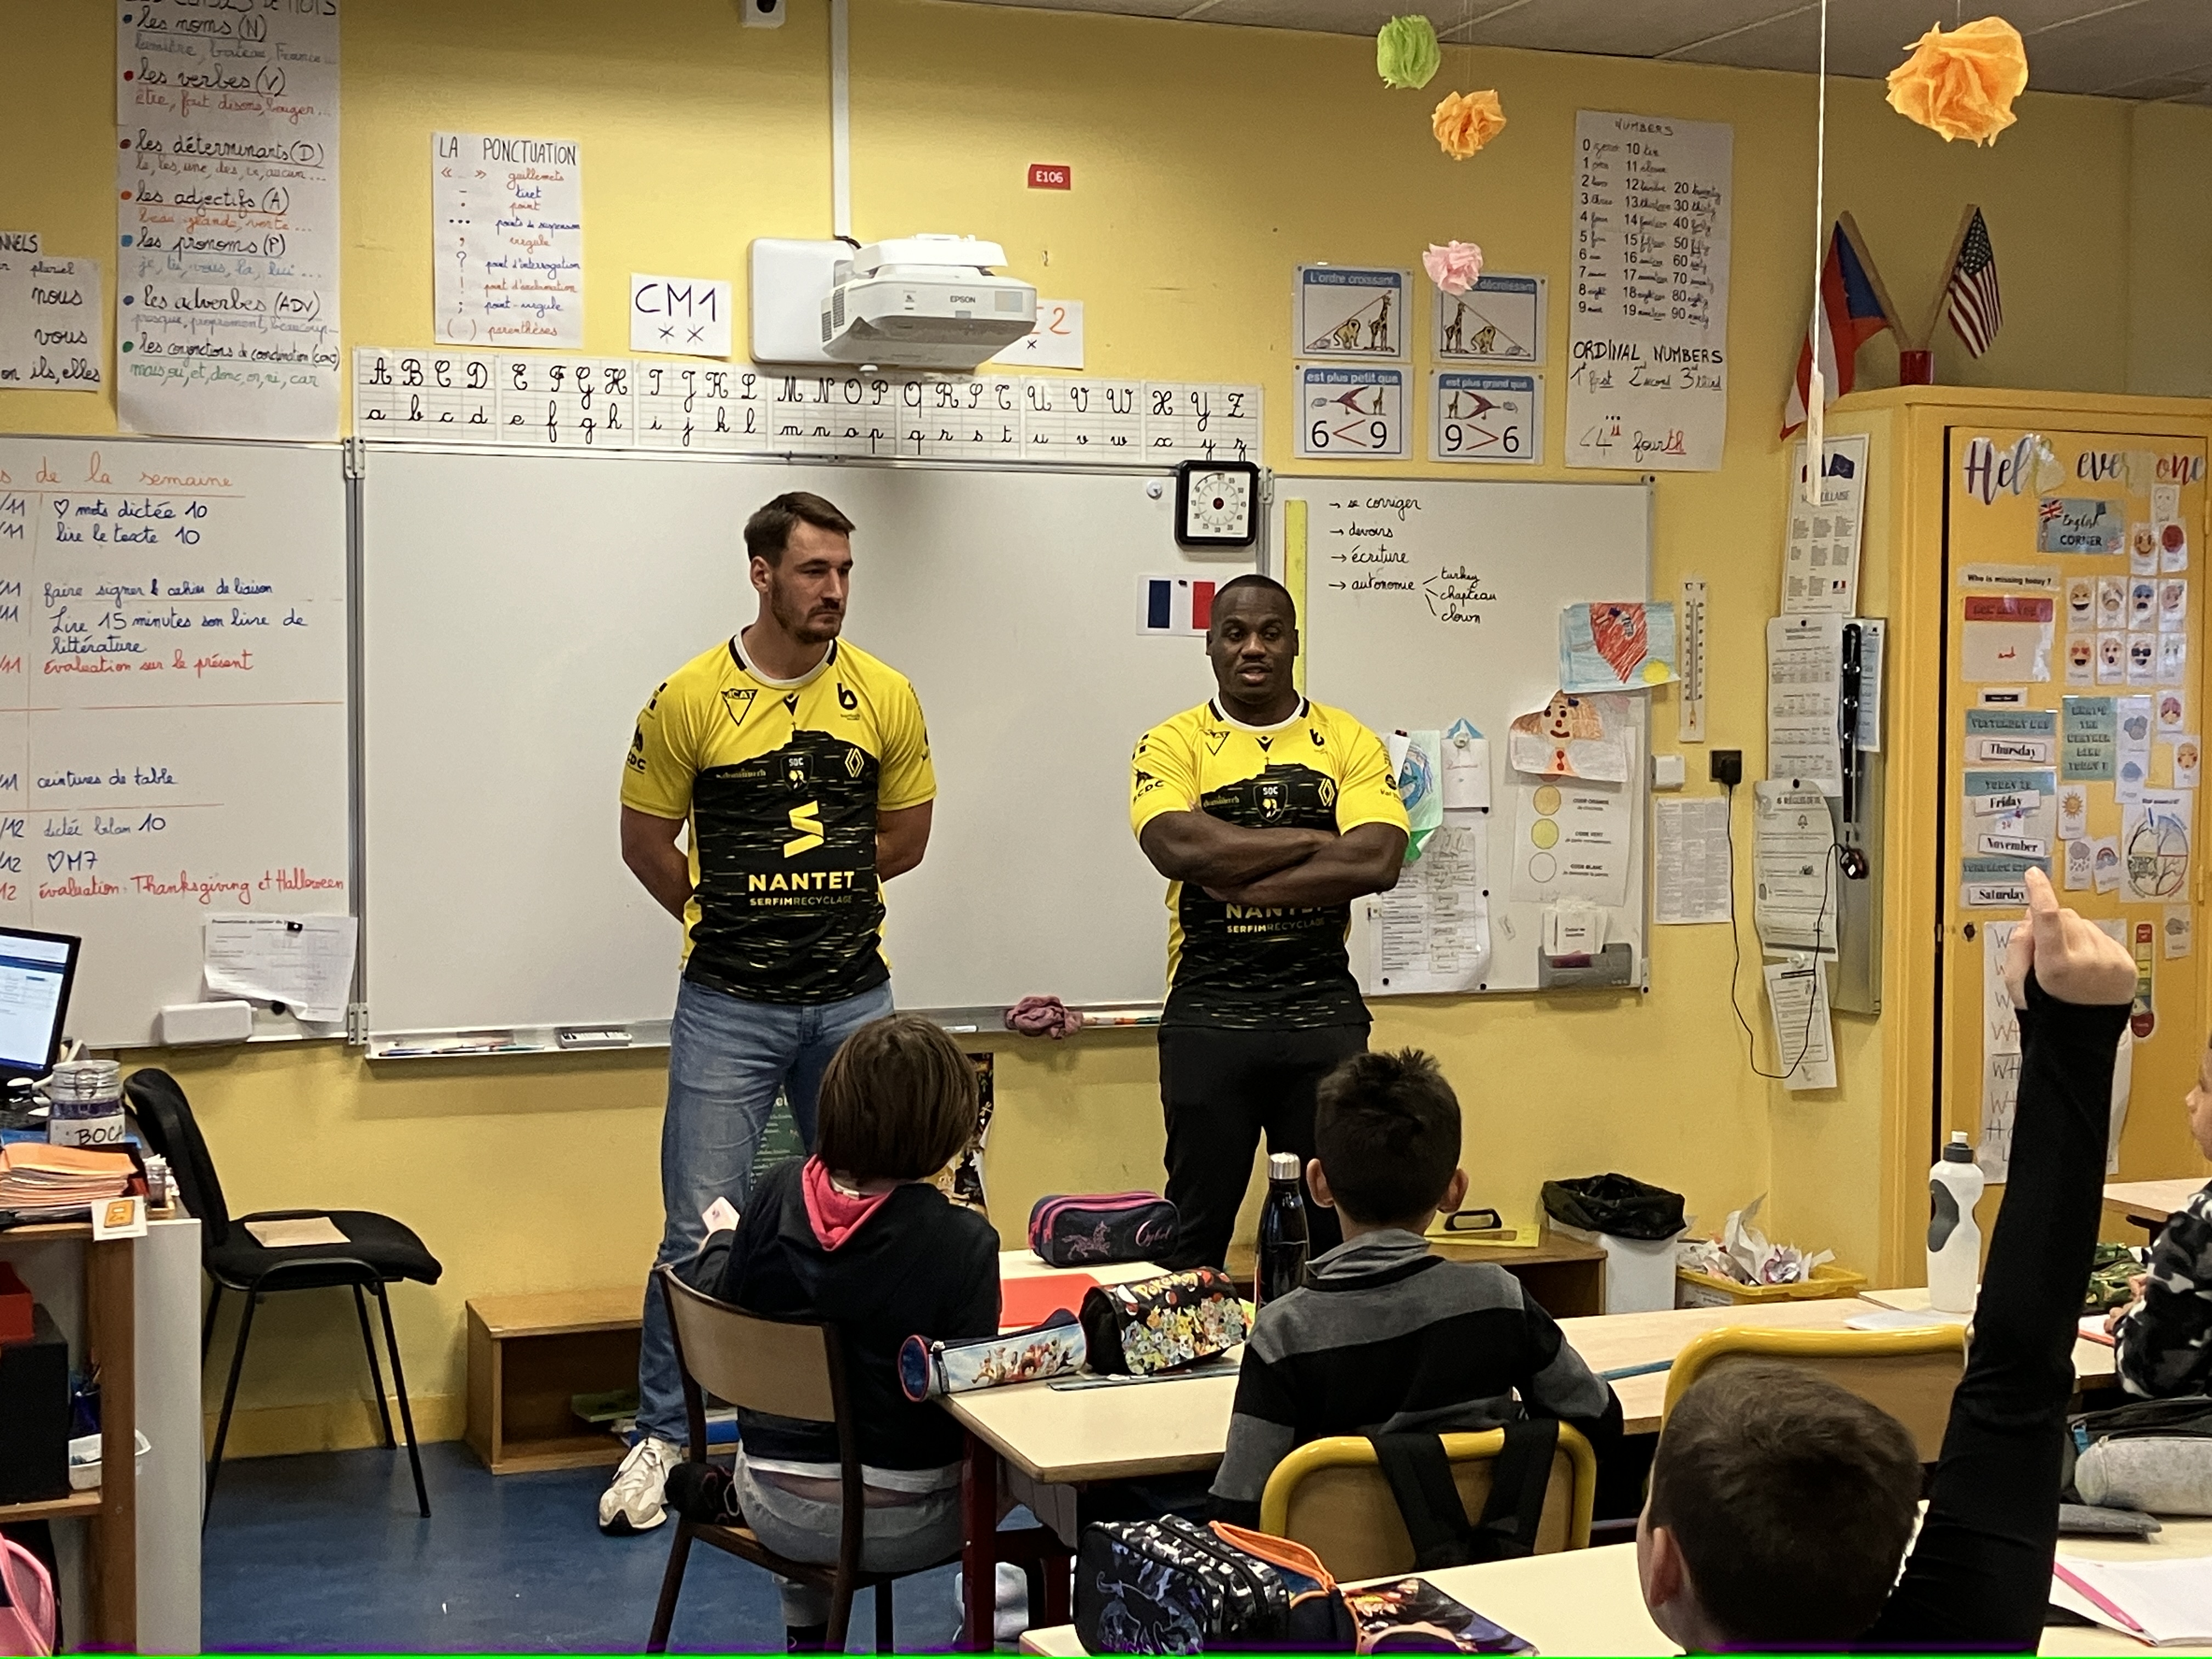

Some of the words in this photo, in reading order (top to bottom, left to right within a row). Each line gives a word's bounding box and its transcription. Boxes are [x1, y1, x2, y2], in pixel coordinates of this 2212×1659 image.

[137, 5, 167, 30] les
[176, 19, 232, 35] noms
[238, 14, 267, 42] (N)
[138, 57, 167, 84] les
[178, 64, 250, 89] verbes
[256, 65, 286, 97] (V)
[1615, 117, 1674, 136] NUMBERS
[136, 128, 162, 151] les
[173, 136, 289, 161] déterminants
[290, 140, 324, 167] (D)
[439, 136, 458, 158] LA
[483, 137, 577, 166] PONCTUATION
[506, 167, 565, 190] guillemets
[1035, 170, 1064, 184] E106
[136, 179, 163, 202] les
[174, 185, 255, 219] adjectifs
[262, 187, 290, 216] (A)
[515, 184, 542, 199] tiret
[509, 200, 540, 217] point
[137, 226, 161, 248] les
[173, 235, 258, 261] pronoms
[264, 233, 286, 257] (P)
[485, 254, 508, 274] point
[1348, 274, 1395, 286] croissant
[31, 287, 83, 306] nous
[144, 284, 167, 308] les
[174, 287, 266, 312] adverbes
[274, 290, 320, 322] (ADV)
[635, 283, 718, 323] CM1
[950, 295, 976, 304] EPSON
[34, 329, 88, 346] vous
[487, 320, 558, 341] parenthèses
[139, 331, 163, 353] les
[1573, 338, 1640, 362] ORDINAL
[1654, 345, 1724, 364] NUMBERS
[62, 357, 100, 383] elles
[1306, 373, 1325, 383] est
[1327, 373, 1348, 384] plus
[1350, 373, 1376, 385] petit
[1378, 375, 1398, 386] que
[1311, 420, 1330, 448] 6
[1370, 421, 1387, 449] 9
[1444, 424, 1463, 452] 9
[1503, 426, 1520, 453] 6
[1632, 428, 1687, 464] fourth
[36, 456, 61, 484] de
[84, 451, 112, 484] la
[139, 469, 233, 487] semaine
[75, 501, 109, 518] mots
[117, 500, 176, 518] dictée
[184, 502, 208, 519] 10
[1365, 497, 1422, 521] corriger
[1348, 521, 1393, 538] devoirs
[2062, 512, 2100, 528] English
[56, 521, 84, 543] lire
[93, 521, 109, 543] le
[113, 522, 159, 544] texte
[174, 528, 200, 545] 10
[2059, 534, 2102, 547] CORNER
[1351, 544, 1409, 564] écriture
[1351, 571, 1415, 591] autonomie
[1441, 566, 1480, 589] turkey
[1967, 574, 1984, 582] Who
[1995, 577, 2023, 585] missing
[2025, 577, 2045, 586] today
[44, 582, 83, 607] faire
[95, 583, 146, 608] signer
[216, 577, 230, 595] de
[234, 578, 273, 595] liaison
[52, 606, 88, 635] Lire
[98, 611, 127, 630] 15
[132, 608, 192, 628] minutes
[201, 614, 225, 628] son
[231, 607, 270, 627] livre
[283, 607, 309, 627] de
[1441, 602, 1480, 624] clown
[52, 635, 148, 655] littérature
[139, 660, 165, 671] sur
[171, 648, 188, 670] le
[194, 649, 254, 679] présent
[1990, 743, 2036, 760] Thursday
[788, 757, 804, 767] SOC
[37, 770, 102, 789] ceintures
[108, 768, 127, 787] de
[134, 766, 179, 788] table
[1263, 786, 1279, 796] SOC
[1990, 795, 2023, 810] Friday
[138, 813, 167, 833] 10
[1987, 837, 2038, 853] November
[130, 870, 251, 905] Thanksgiving
[258, 870, 272, 890] et
[275, 867, 345, 893] Halloween
[748, 871, 855, 891] NANTET
[1978, 888, 2025, 902] Saturday
